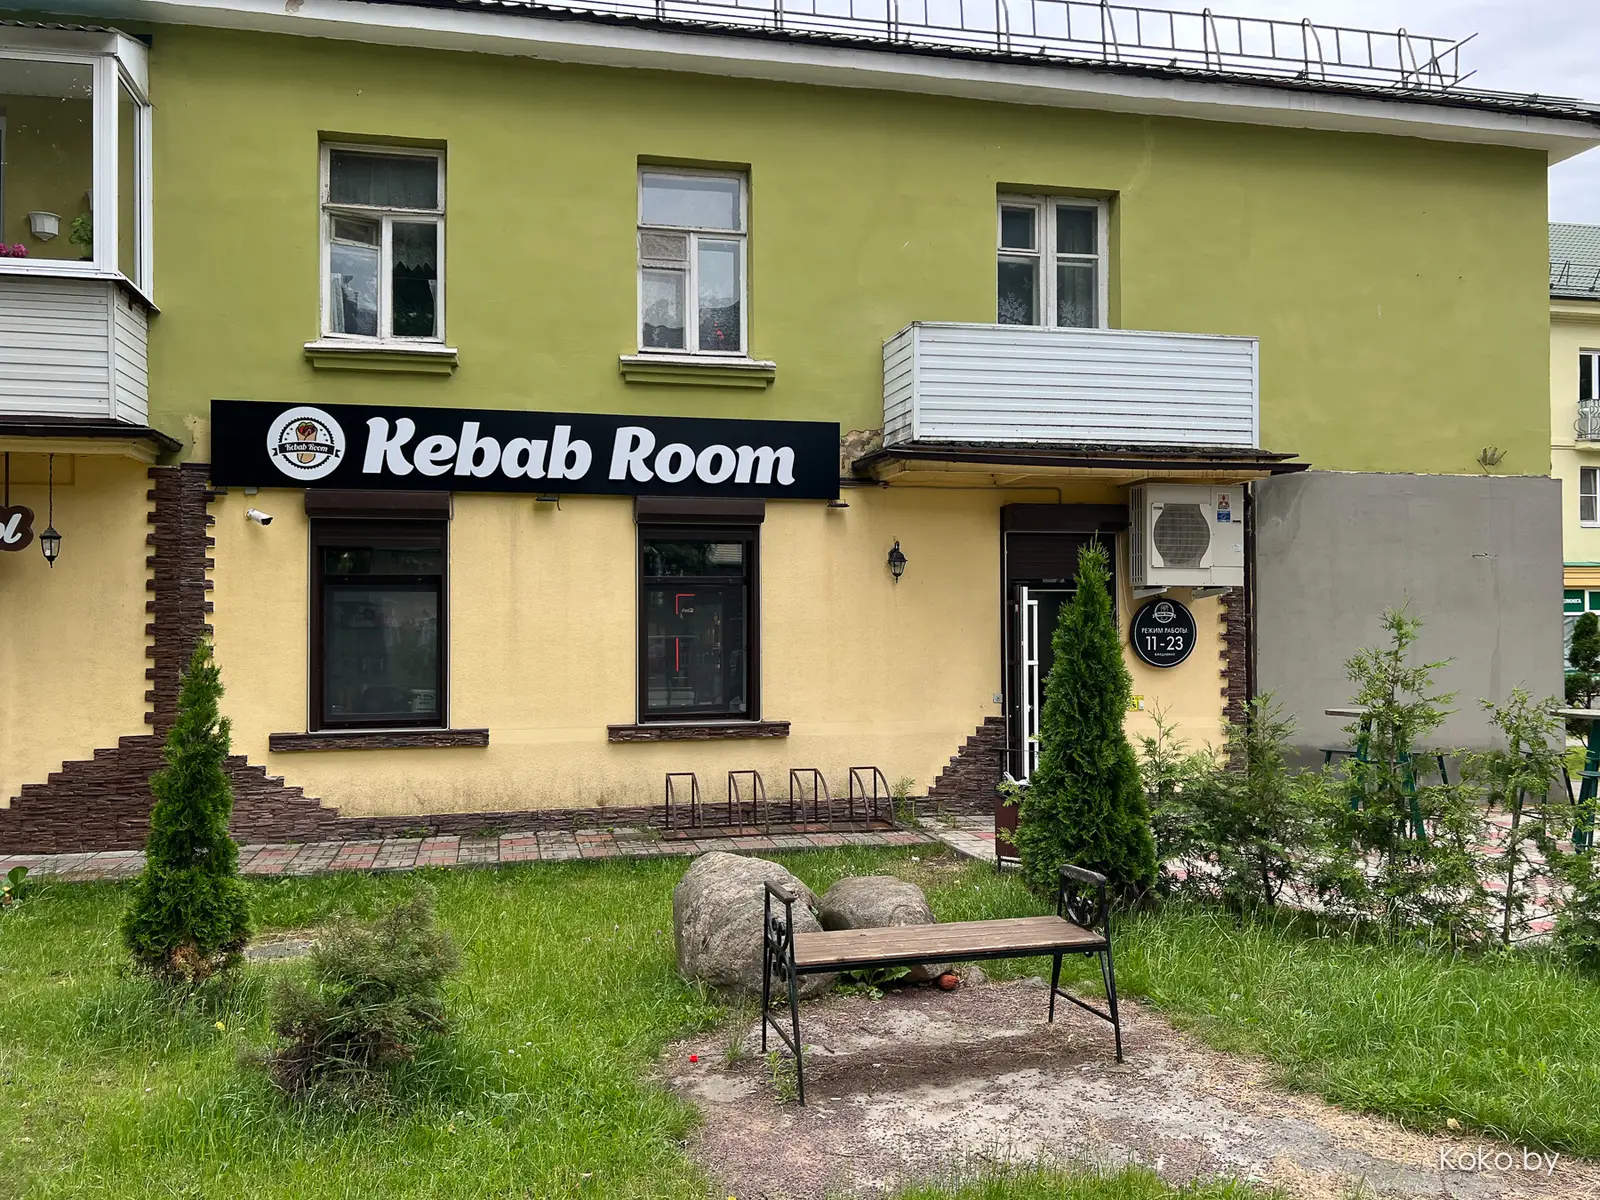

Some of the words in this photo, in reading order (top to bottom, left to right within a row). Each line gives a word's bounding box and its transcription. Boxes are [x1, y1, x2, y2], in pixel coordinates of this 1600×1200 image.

[284, 443, 307, 451] Kebab
[308, 443, 328, 452] Room
[362, 416, 592, 480] Kebab
[608, 424, 796, 486] Room
